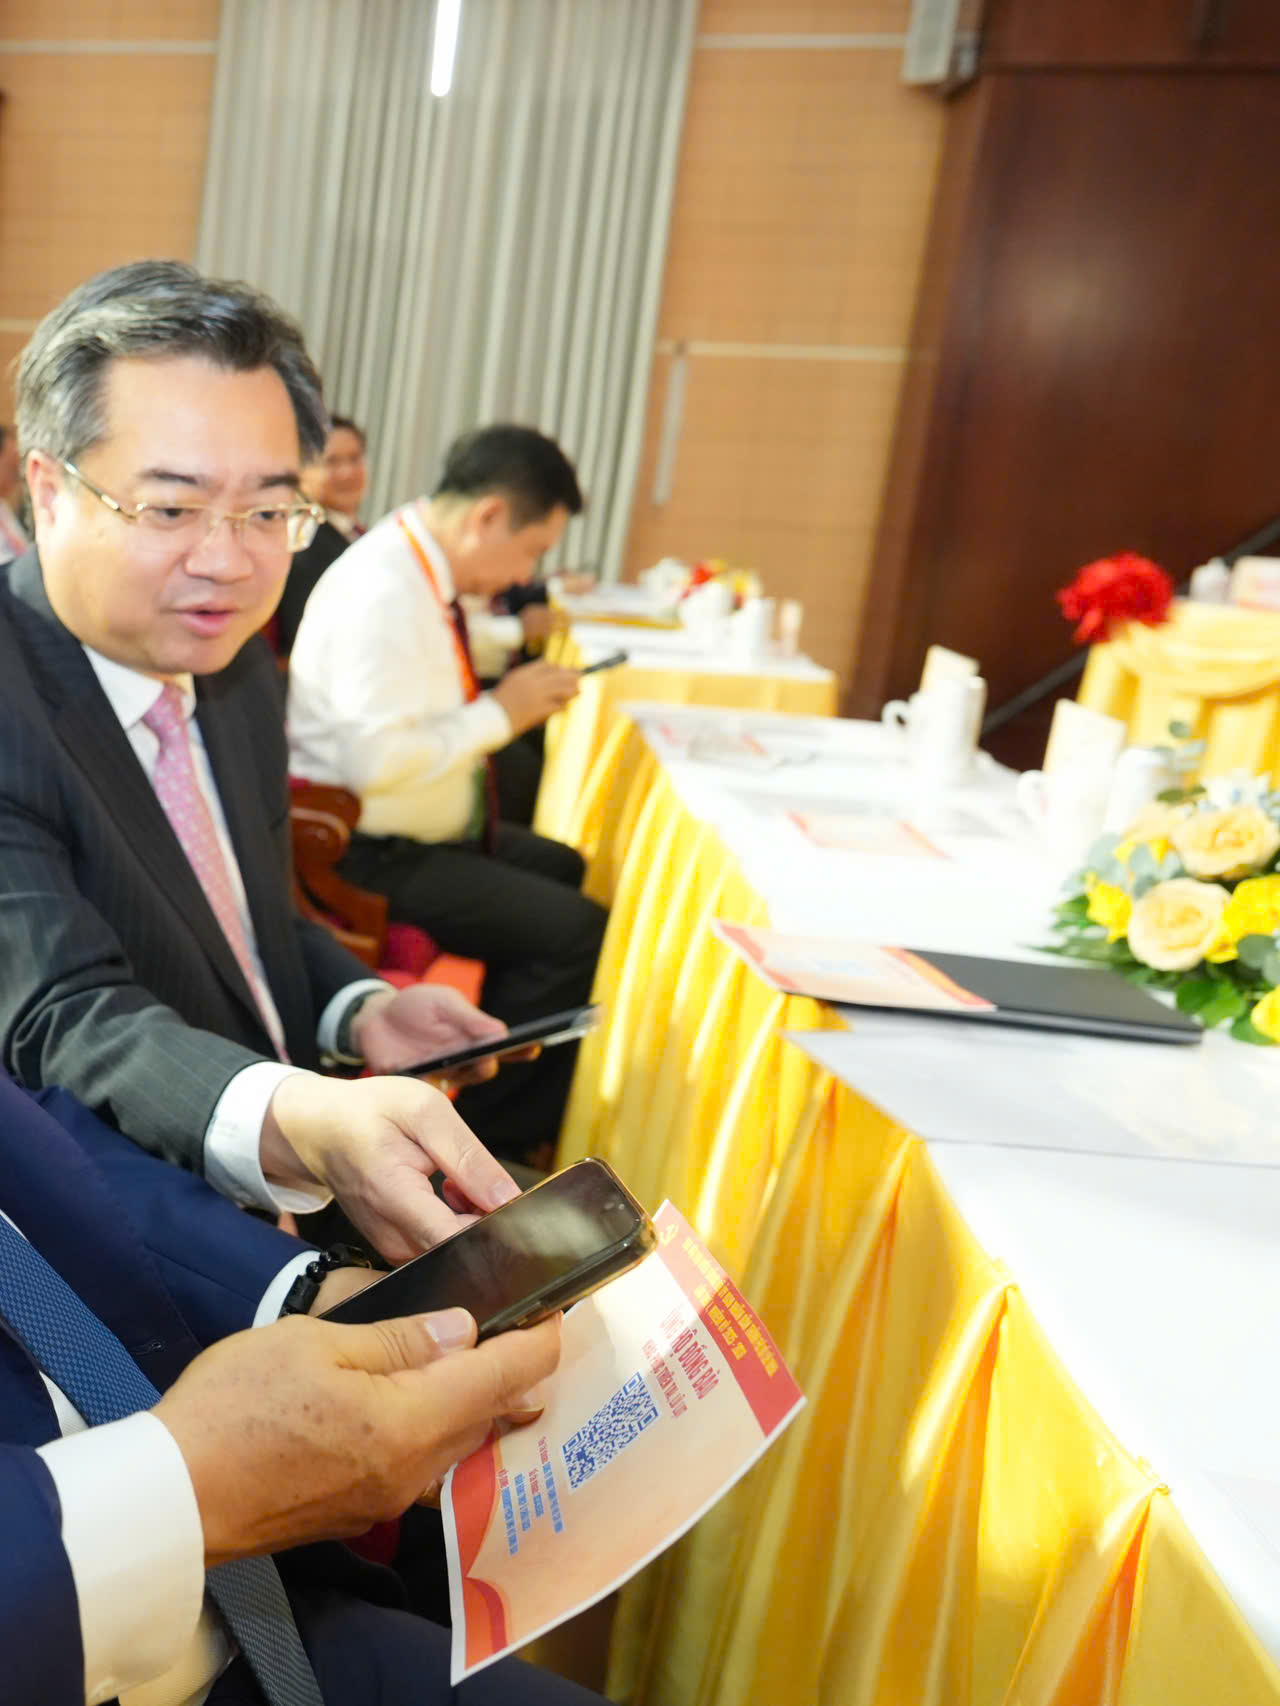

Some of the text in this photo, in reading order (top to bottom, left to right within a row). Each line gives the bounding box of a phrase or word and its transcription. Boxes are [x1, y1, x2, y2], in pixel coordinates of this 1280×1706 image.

[670, 1327, 698, 1358] HỘ
[678, 1340, 708, 1380] ĐỒNG
[692, 1367, 721, 1400] BÀO
